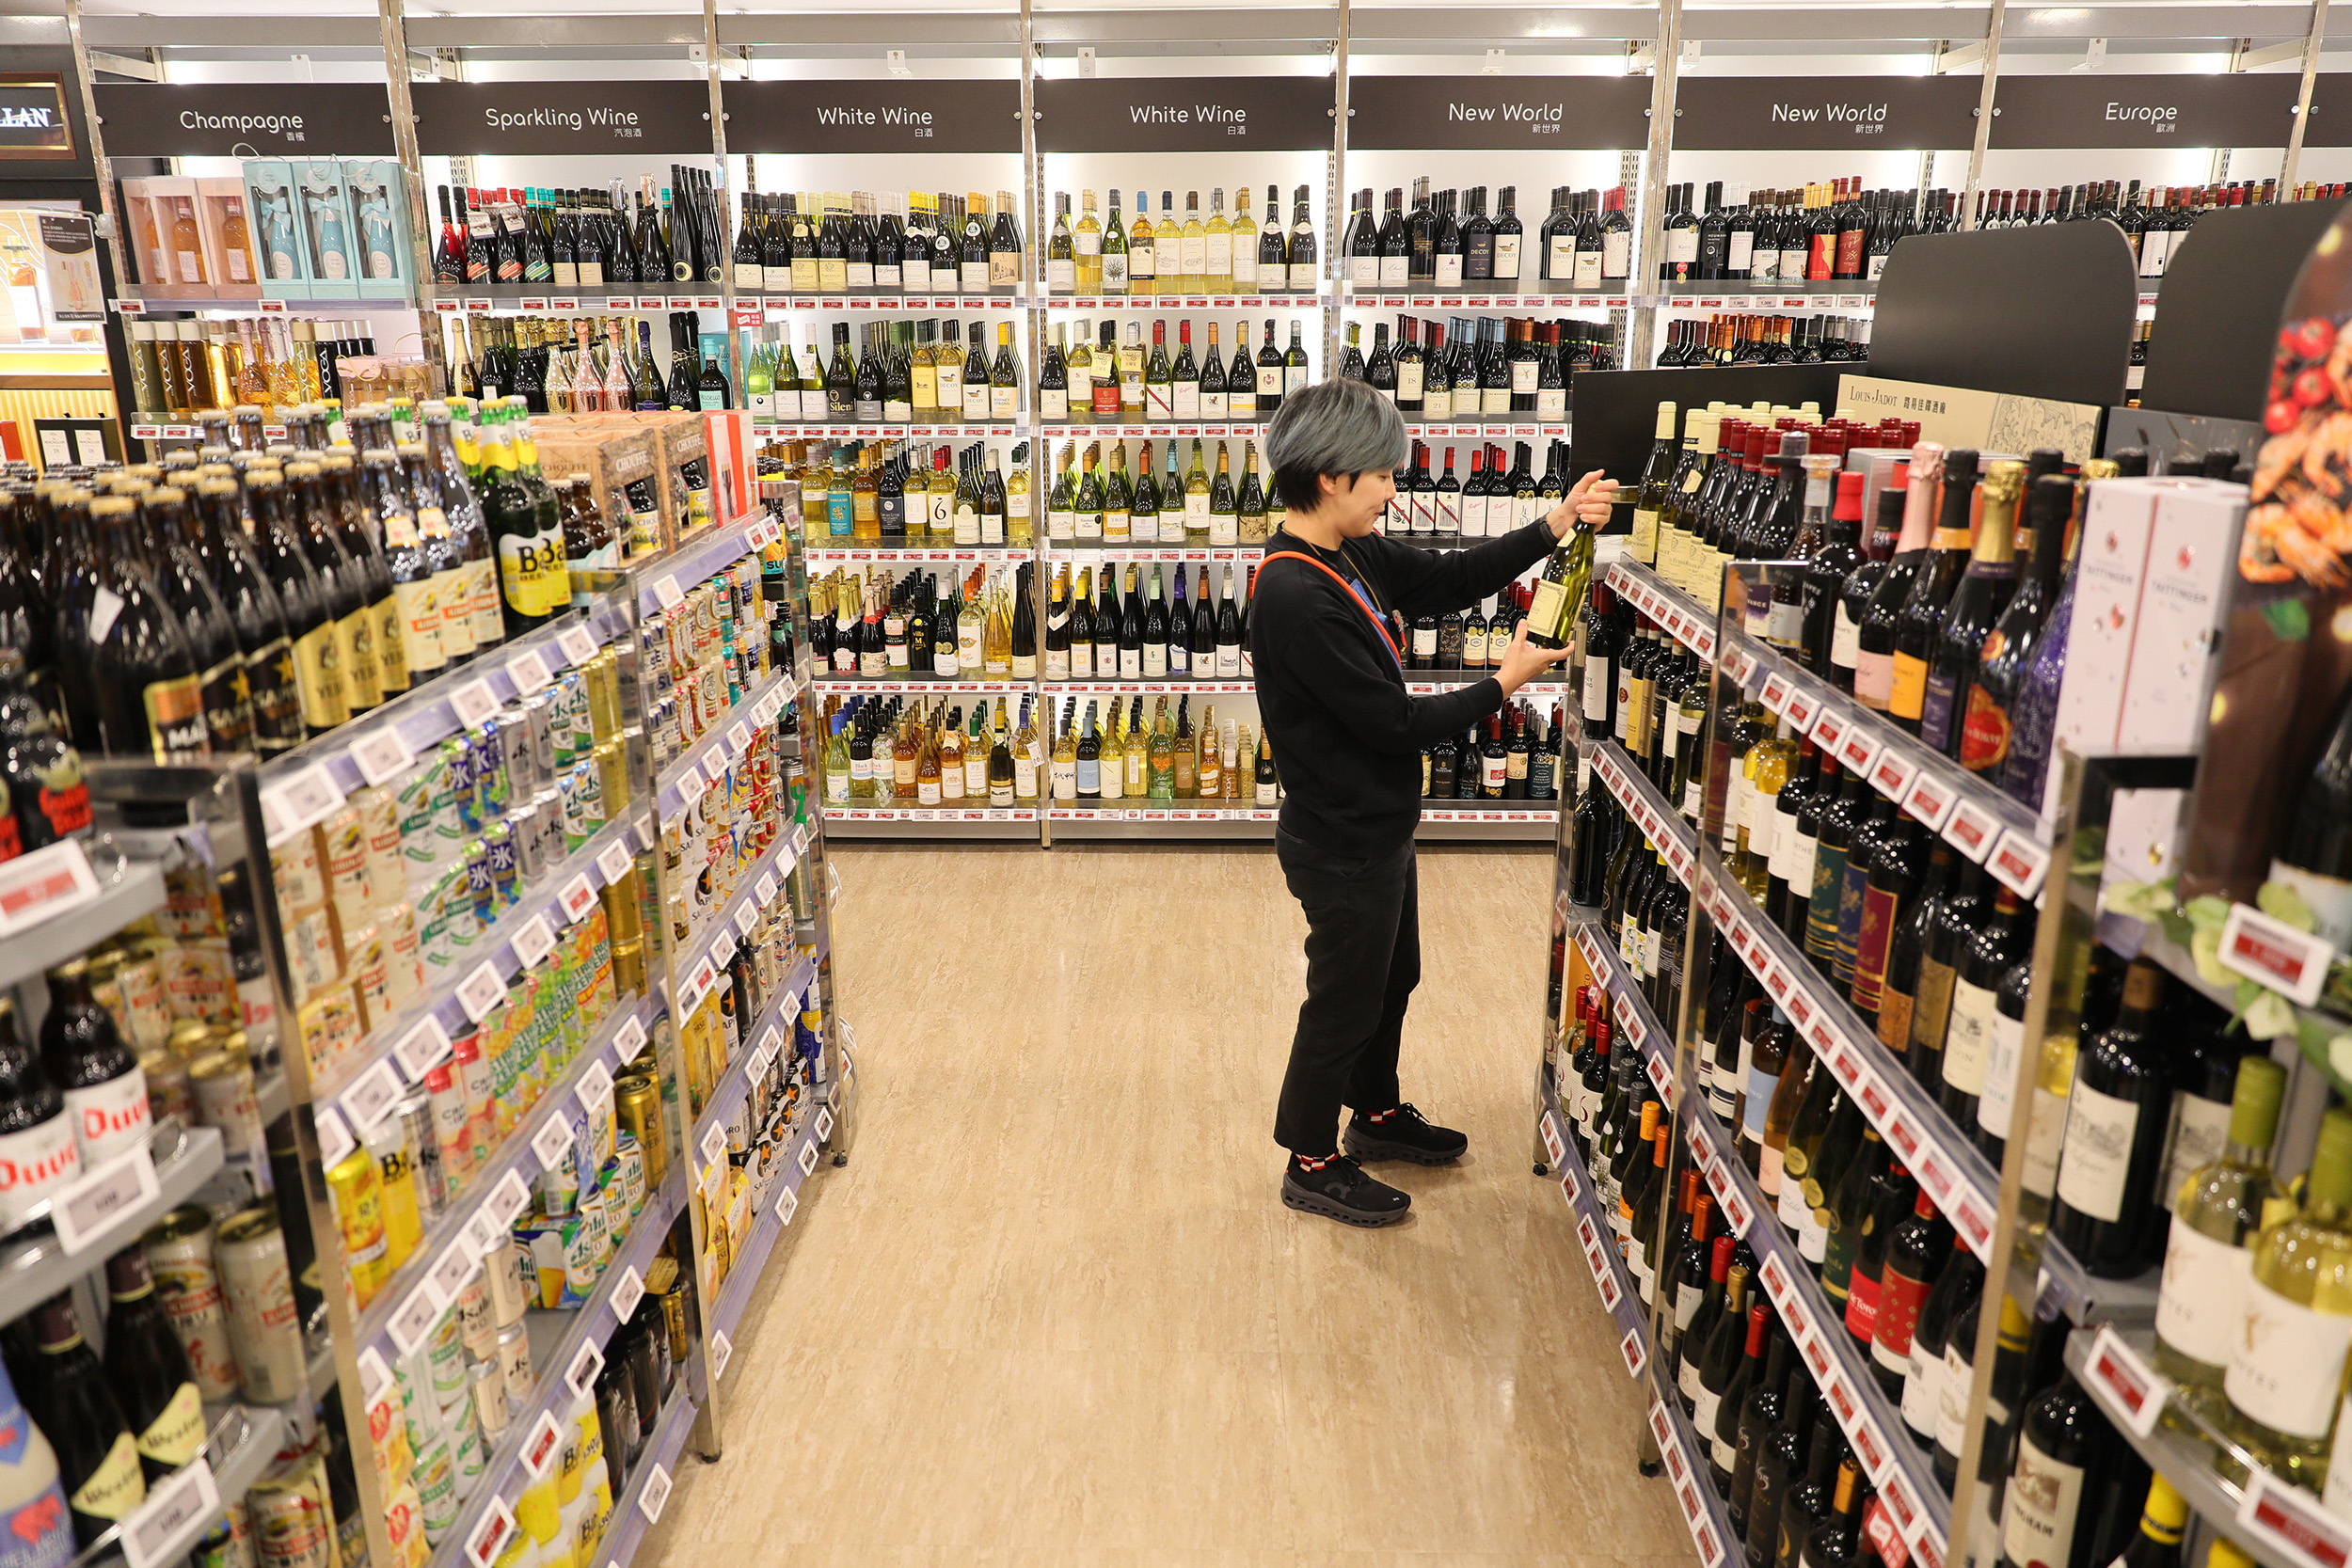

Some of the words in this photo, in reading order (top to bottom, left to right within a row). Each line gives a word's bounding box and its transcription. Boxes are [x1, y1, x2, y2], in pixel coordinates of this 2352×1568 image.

[180, 110, 304, 134] Champagne
[485, 107, 582, 131] Sparkling
[587, 107, 639, 126] Wine
[817, 106, 876, 125] White
[882, 106, 933, 125] Wine
[1129, 105, 1189, 123] White
[1195, 104, 1247, 123] Wine
[1449, 103, 1496, 121] New
[1502, 103, 1563, 121] World
[1772, 103, 1820, 122] New
[1826, 103, 1888, 122] World
[2105, 102, 2178, 126] Europe
[613, 128, 643, 138] 汽泡酒
[914, 128, 933, 137] 白酒
[1227, 125, 1247, 135] 白酒
[1532, 123, 1561, 134] 新世界
[1854, 123, 1884, 135] 新世界
[2155, 123, 2176, 134] 歐洲
[135, 349, 148, 392] VOGA
[159, 349, 173, 392] VOGA
[182, 348, 196, 392] VOGA
[297, 349, 310, 392] VOGA
[320, 349, 333, 393] VOGA
[1407, 376, 1417, 385] 18
[829, 400, 854, 412] Sileni
[1850, 386, 1870, 403] LOUIS
[1871, 388, 1898, 407] JADOT
[676, 433, 703, 453] CHOUFFE
[616, 451, 648, 472] CHOUFFE
[934, 499, 947, 522] 6
[1857, 1296, 1879, 1316] Toro
